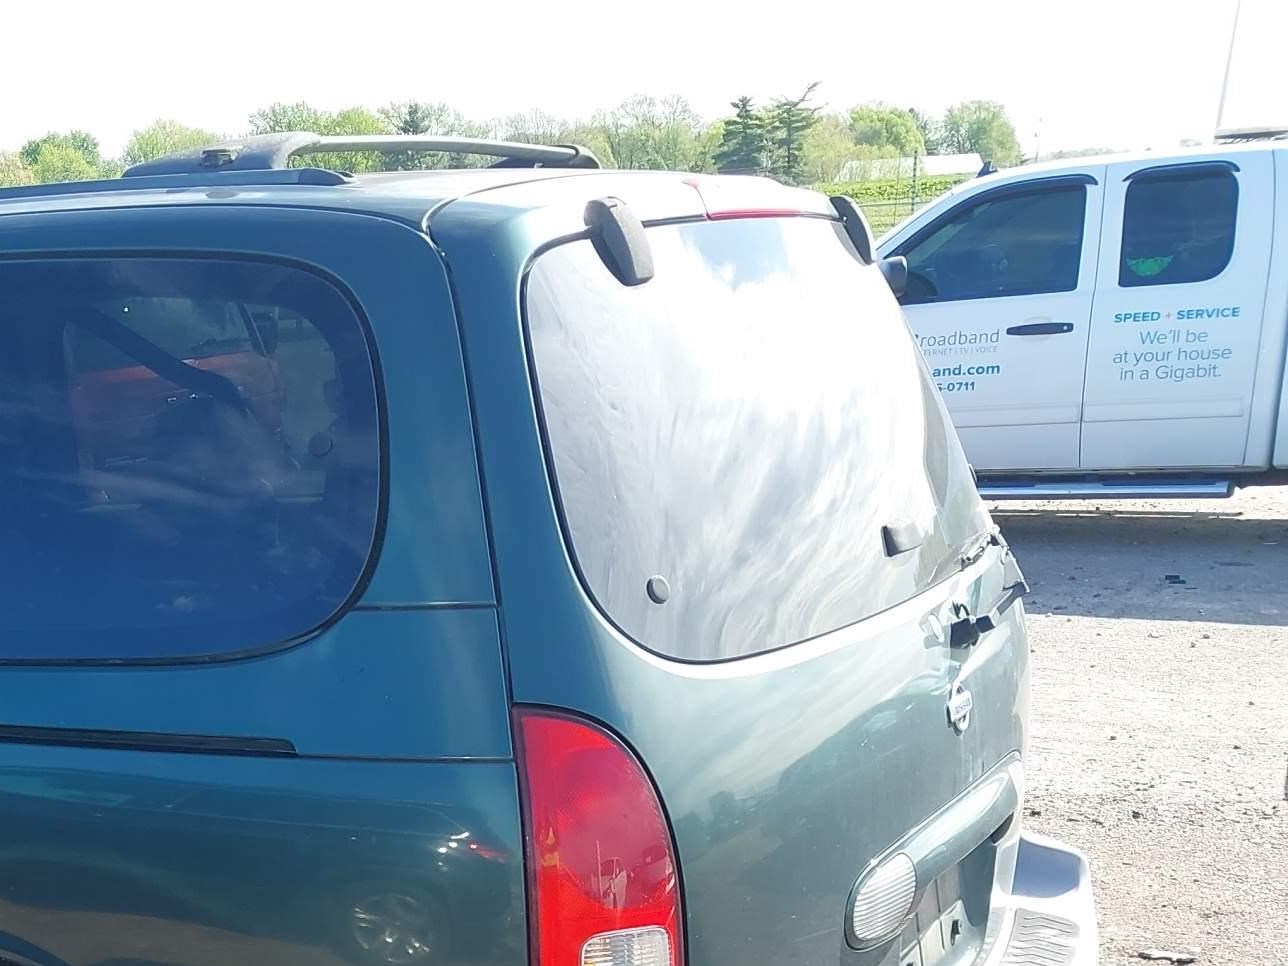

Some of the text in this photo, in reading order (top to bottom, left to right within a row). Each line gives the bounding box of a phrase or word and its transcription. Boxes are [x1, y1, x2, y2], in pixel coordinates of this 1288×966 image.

[1113, 311, 1161, 323] SPEED
[1176, 307, 1241, 320] SERVICE
[1185, 328, 1209, 343] be
[923, 347, 953, 357] TERNET
[1112, 347, 1233, 367] at your house
[932, 364, 1001, 377] and.com
[1119, 364, 1222, 383] in a Gigabit.
